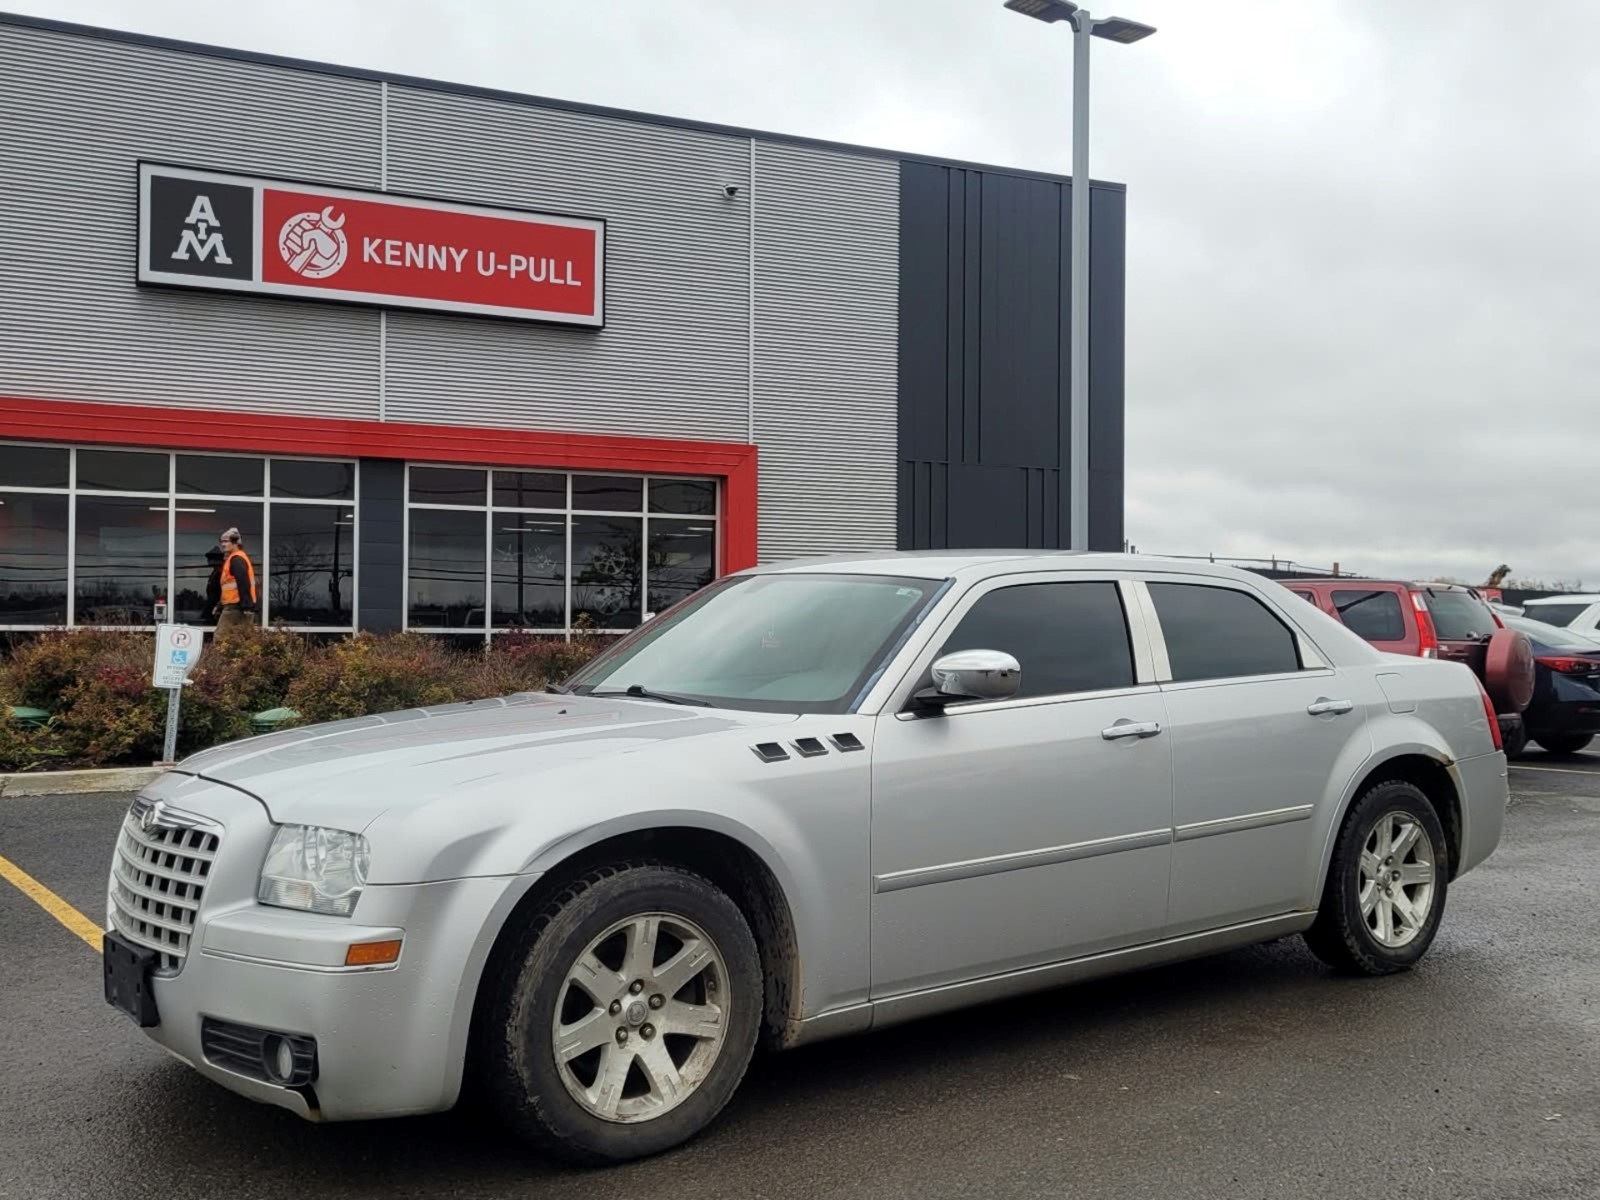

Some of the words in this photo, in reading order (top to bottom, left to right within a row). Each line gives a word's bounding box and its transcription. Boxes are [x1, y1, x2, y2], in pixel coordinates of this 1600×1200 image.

[363, 236, 468, 273] KENNY
[477, 250, 582, 286] U-PULL
[176, 633, 187, 645] P
